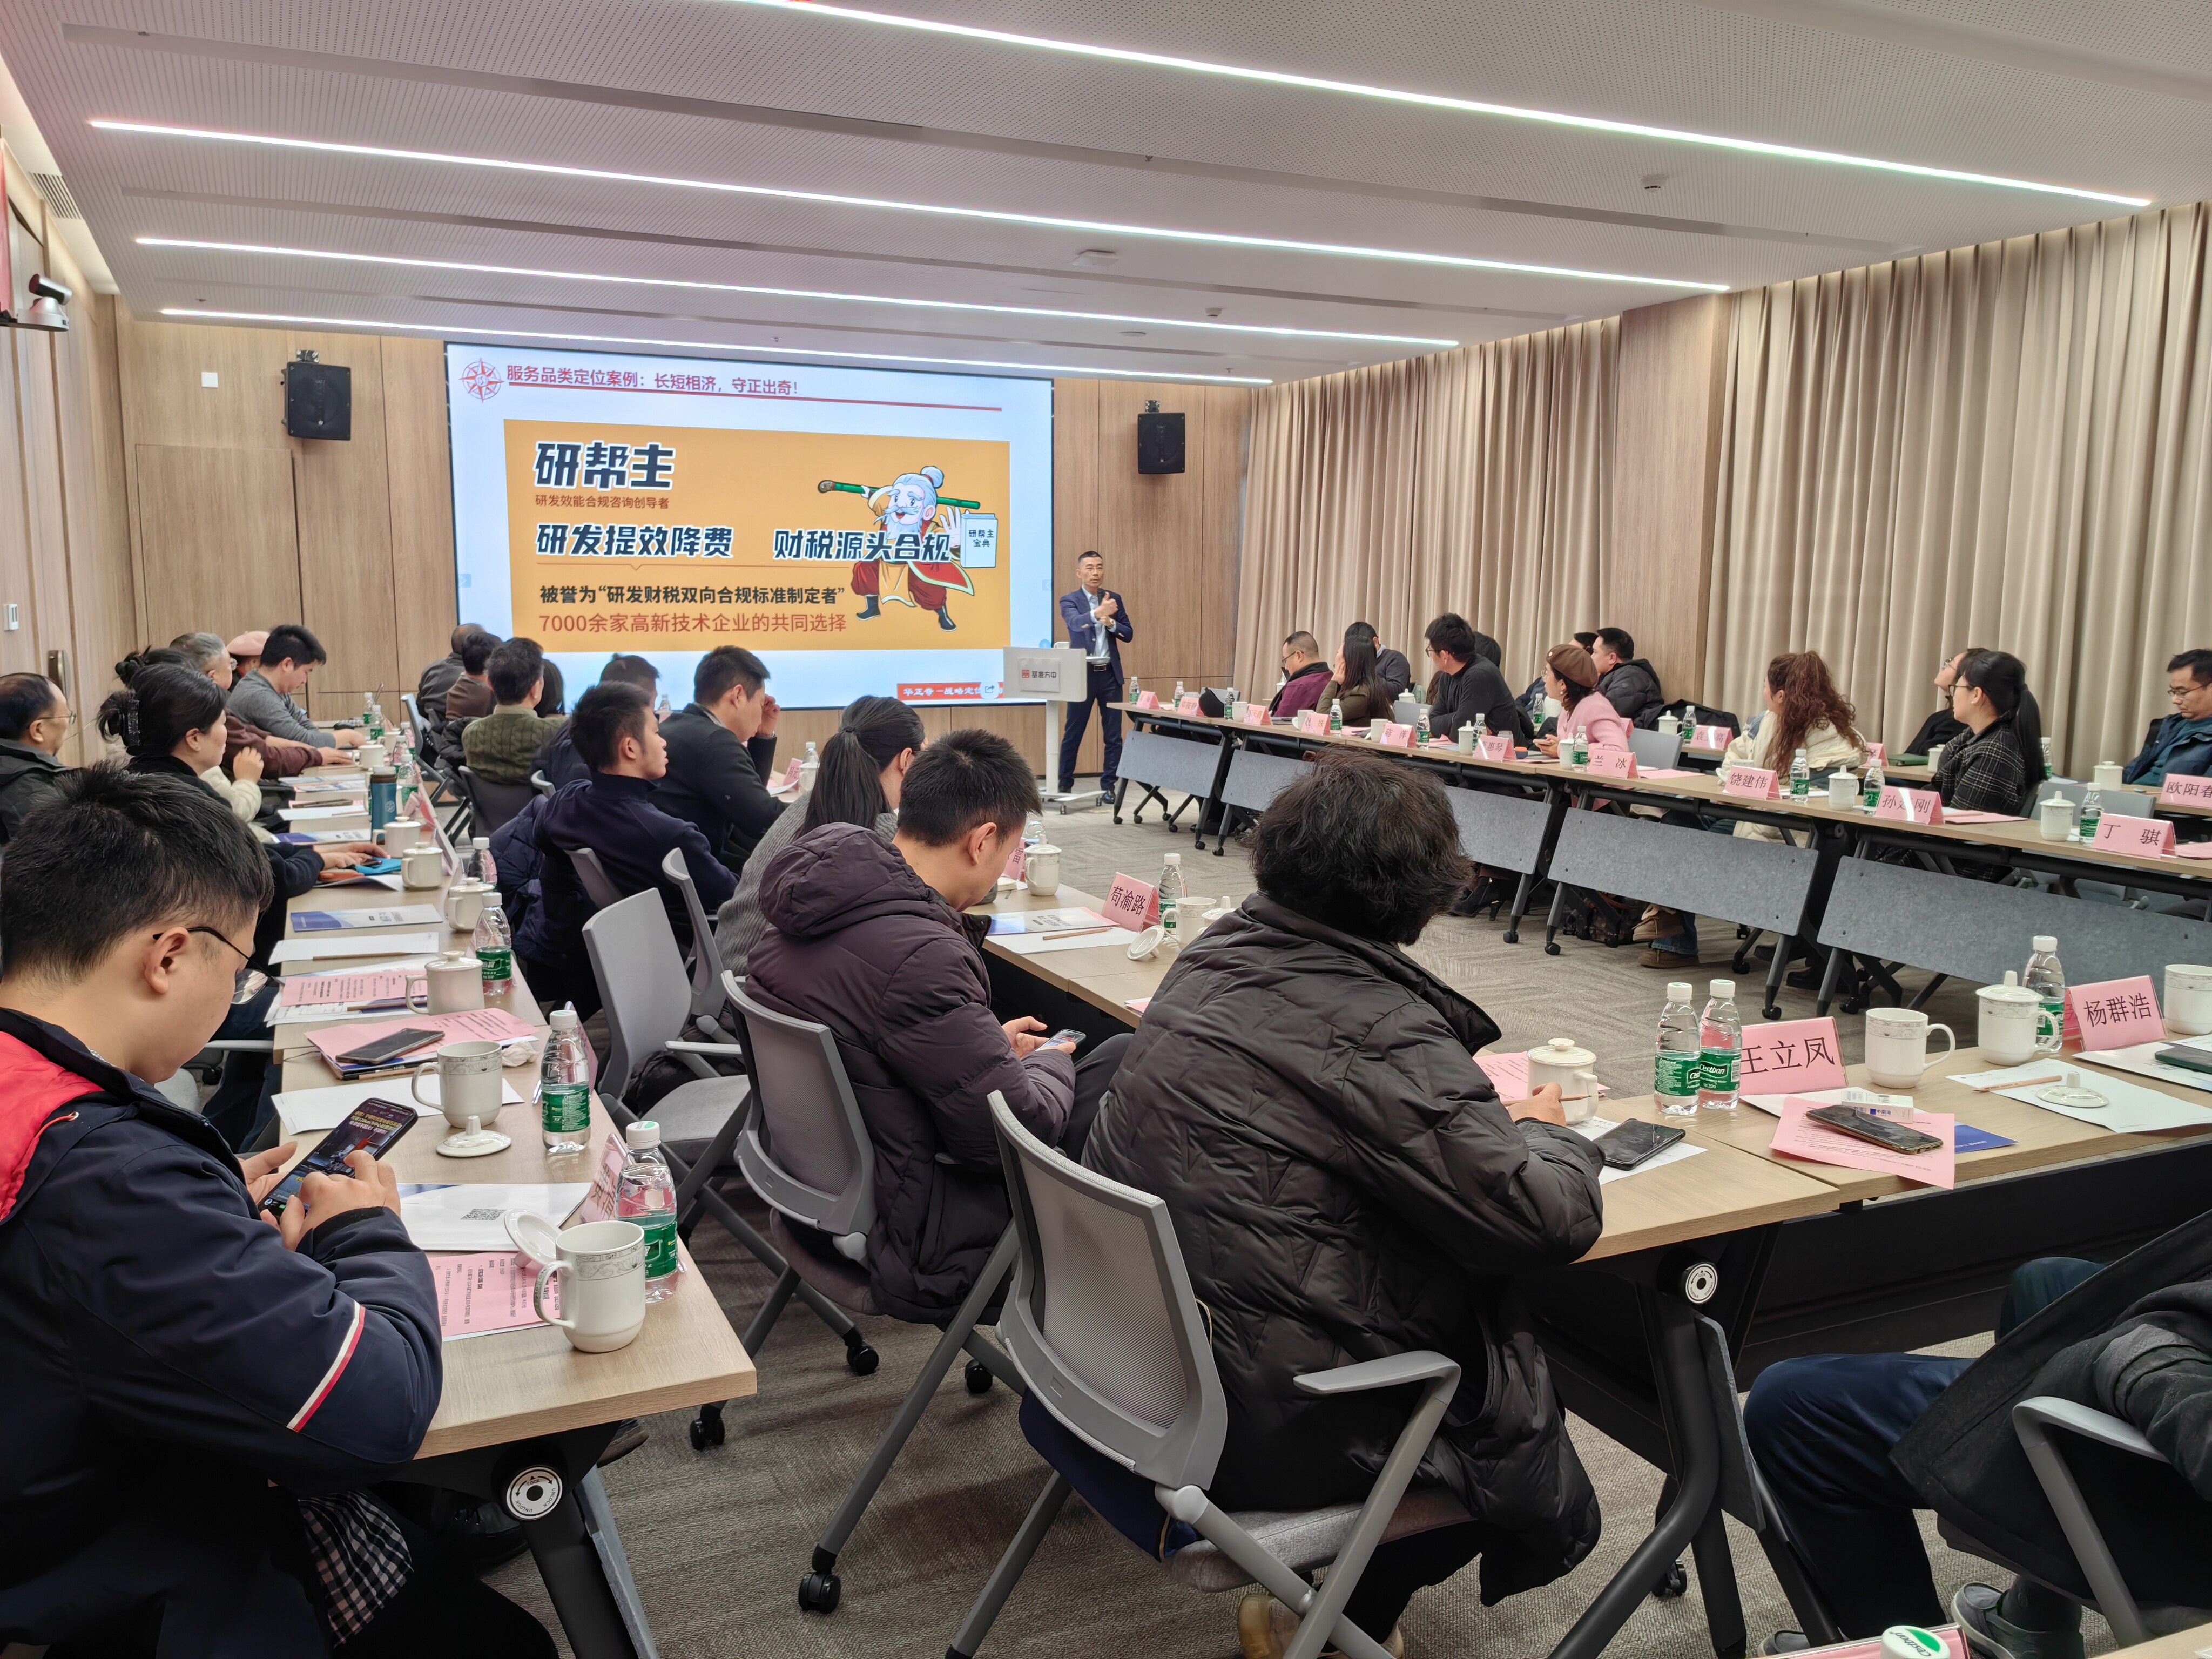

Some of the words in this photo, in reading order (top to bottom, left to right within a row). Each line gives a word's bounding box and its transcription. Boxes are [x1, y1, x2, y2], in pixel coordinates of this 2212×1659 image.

[533, 441, 676, 490] 研帮主
[535, 494, 670, 510] 研发效能合规咨询创导者
[536, 522, 734, 558] 研发提效降费
[968, 529, 994, 538] 研帮主
[772, 529, 953, 562] 财税源头合规
[973, 538, 990, 548] 宝典
[539, 613, 847, 633] 7000余家高新技术企业的共同选择
[1592, 755, 1628, 770] 兰冰
[1730, 772, 1768, 789] 饶建伟
[2166, 781, 2212, 798] 欧阳春
[1110, 886, 1146, 916] 苟渝路
[2083, 993, 2153, 1027] 杨群浩
[1740, 1037, 1835, 1075] 王立凤
[1700, 1064, 1725, 1075] Cestbon
